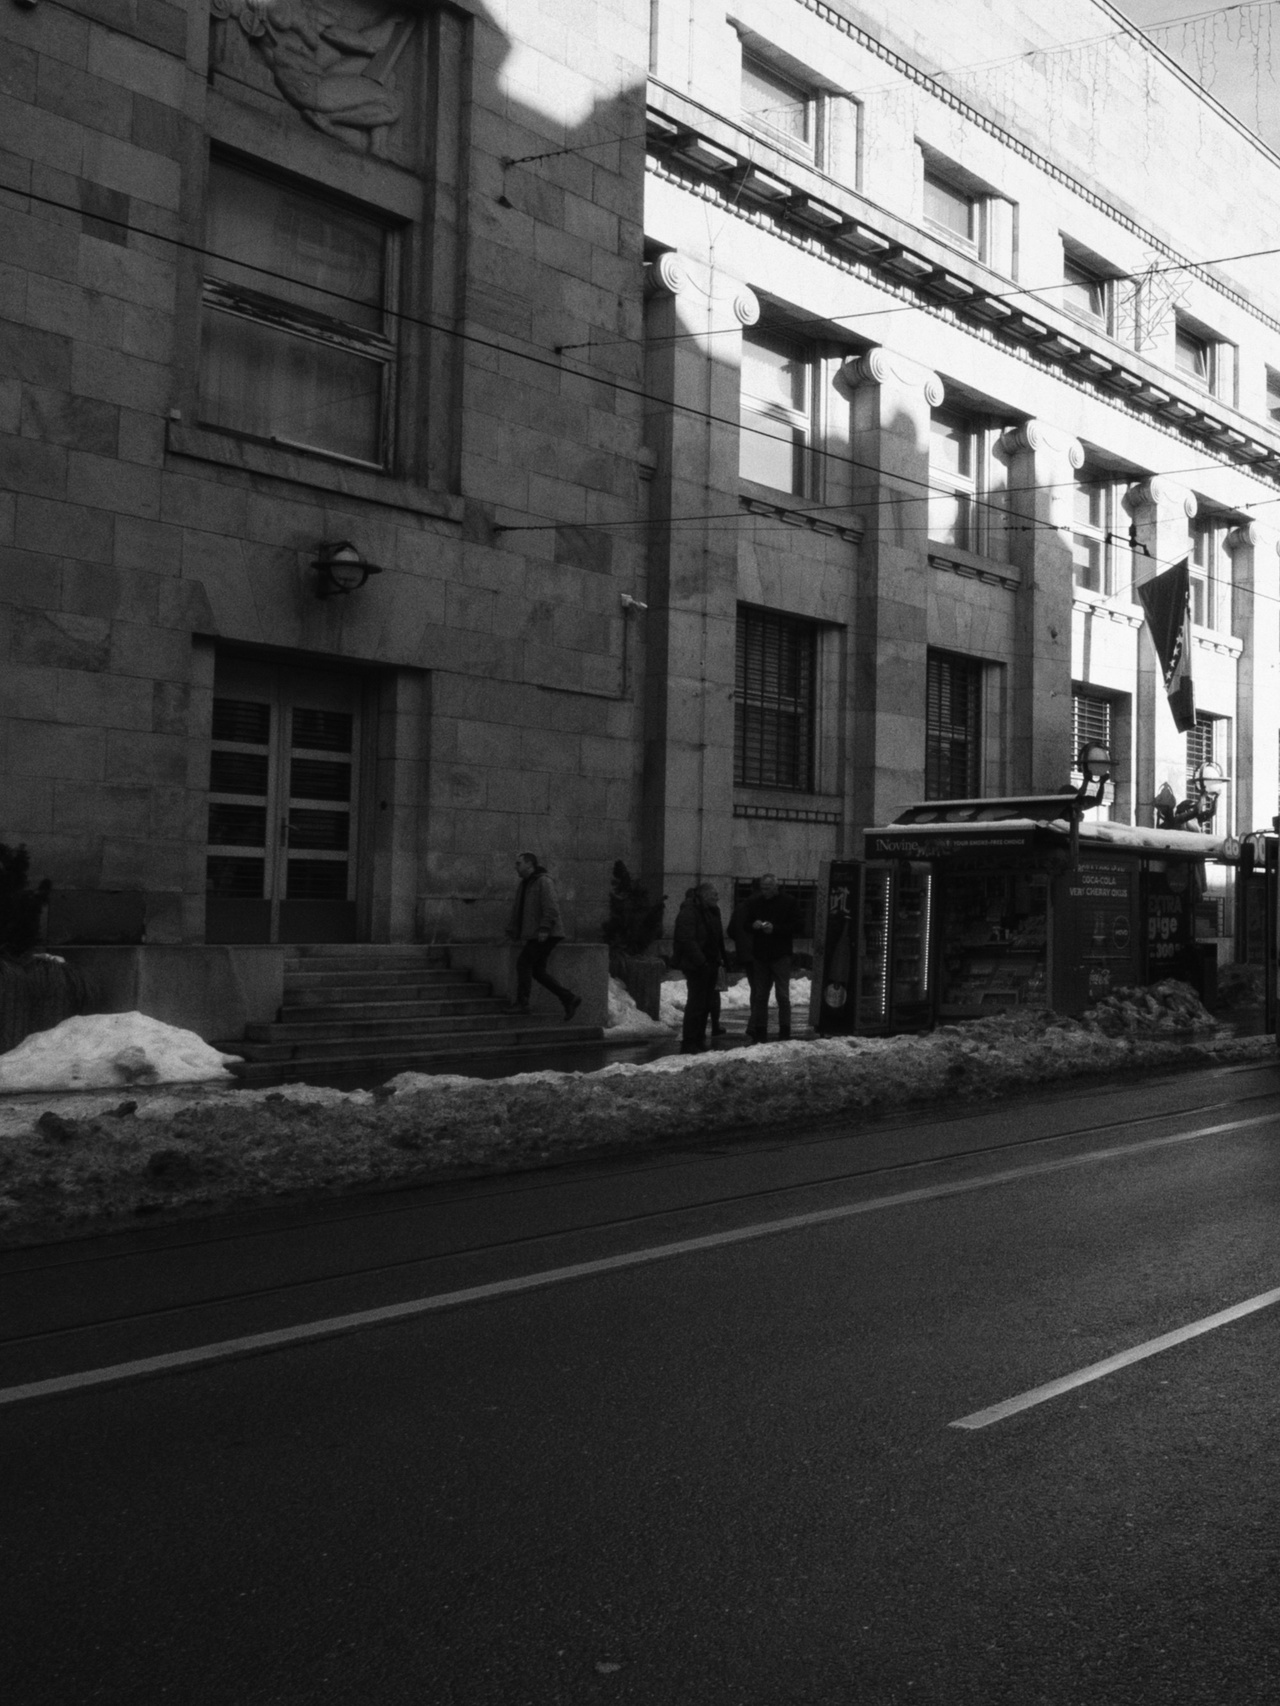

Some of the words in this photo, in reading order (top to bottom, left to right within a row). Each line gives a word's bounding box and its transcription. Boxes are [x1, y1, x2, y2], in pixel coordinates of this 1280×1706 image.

[953, 839, 969, 847] YOUR
[1003, 838, 1026, 846] CHOICE
[1081, 874, 1117, 886] COCA-COLA
[1069, 887, 1085, 897] VERY
[1086, 887, 1111, 897] CHERRY
[1147, 894, 1183, 913] EXTRA
[1148, 909, 1178, 940] gige
[1156, 942, 1175, 959] 300
